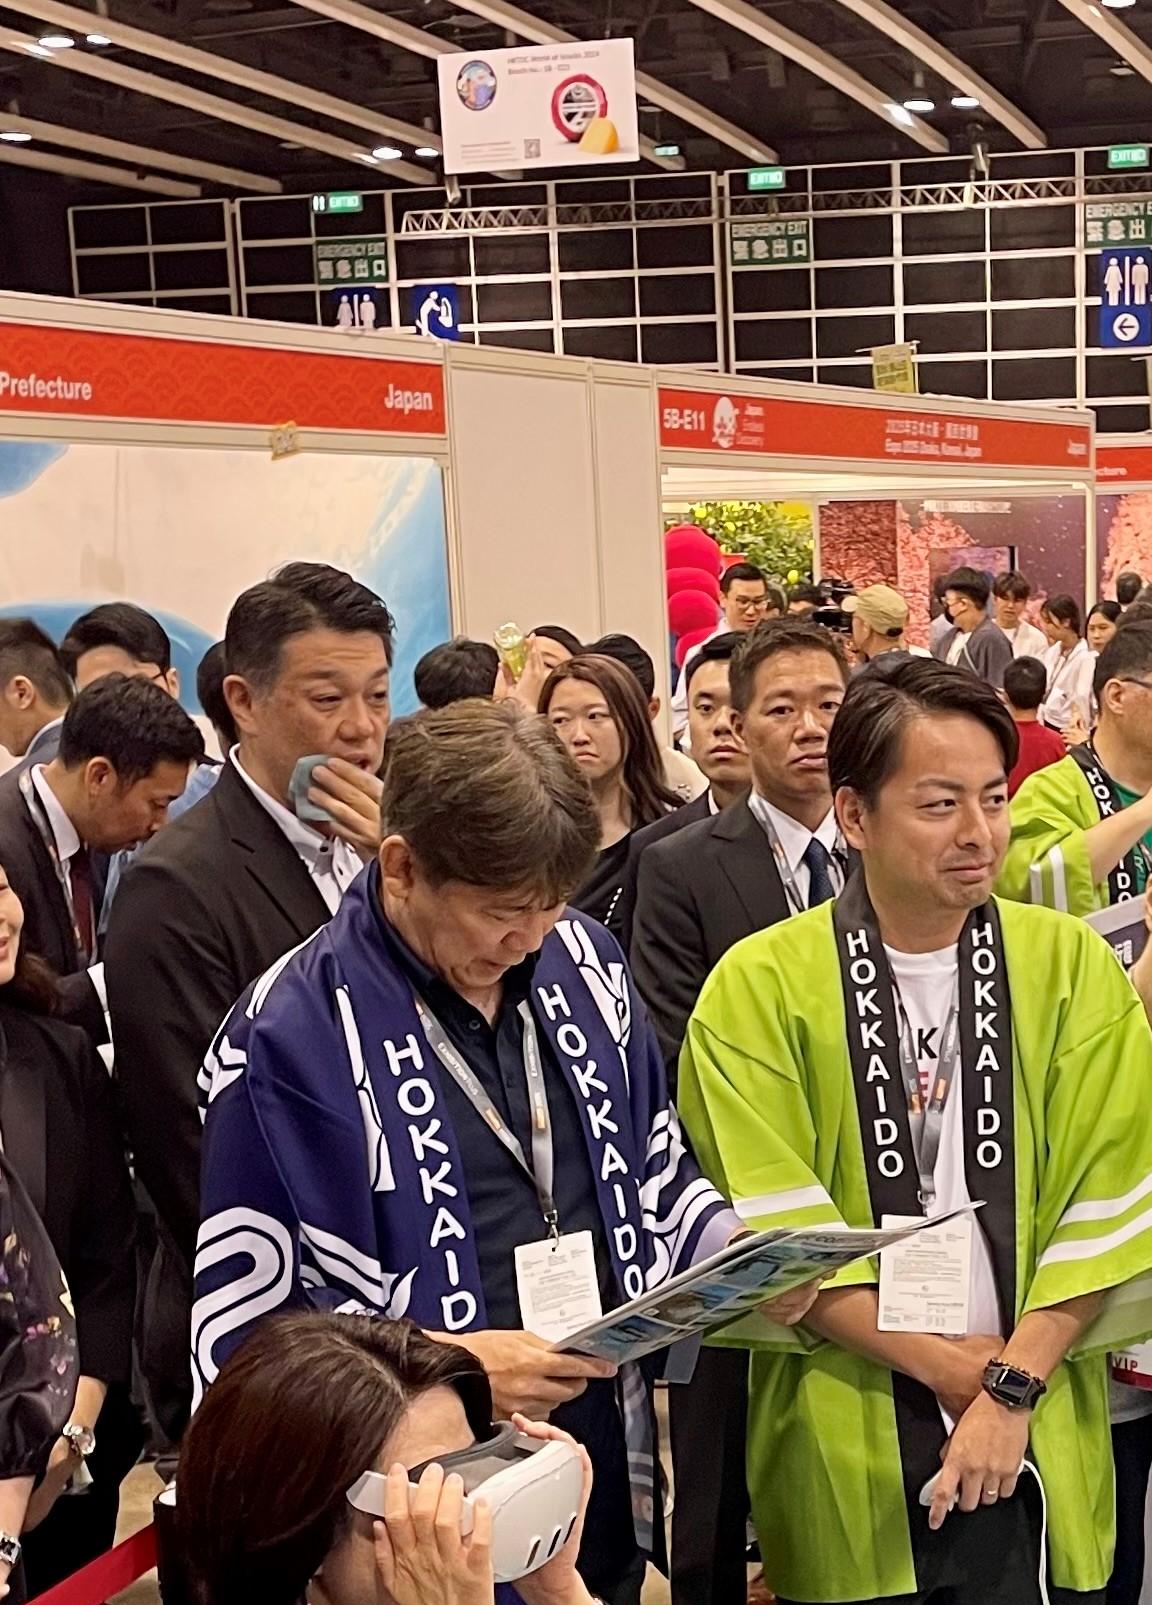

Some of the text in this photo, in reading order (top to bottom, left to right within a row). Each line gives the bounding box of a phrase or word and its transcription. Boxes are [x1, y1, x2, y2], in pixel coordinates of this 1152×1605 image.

[1085, 203, 1145, 219] EMERGENCY
[731, 220, 808, 238] EMERGENCY EXIT
[317, 241, 385, 258] EMERGENCY EXIT
[0, 372, 92, 401] Prefecture
[384, 384, 433, 414] Japan
[663, 408, 706, 431] 5B-E11
[846, 928, 904, 1179] HOKKAIDO
[970, 921, 1002, 1170] HOKKAIDO
[536, 983, 644, 1301] HOKKAIDO
[383, 1033, 477, 1331] HOKKAID
[1114, 1356, 1138, 1371] VIP
